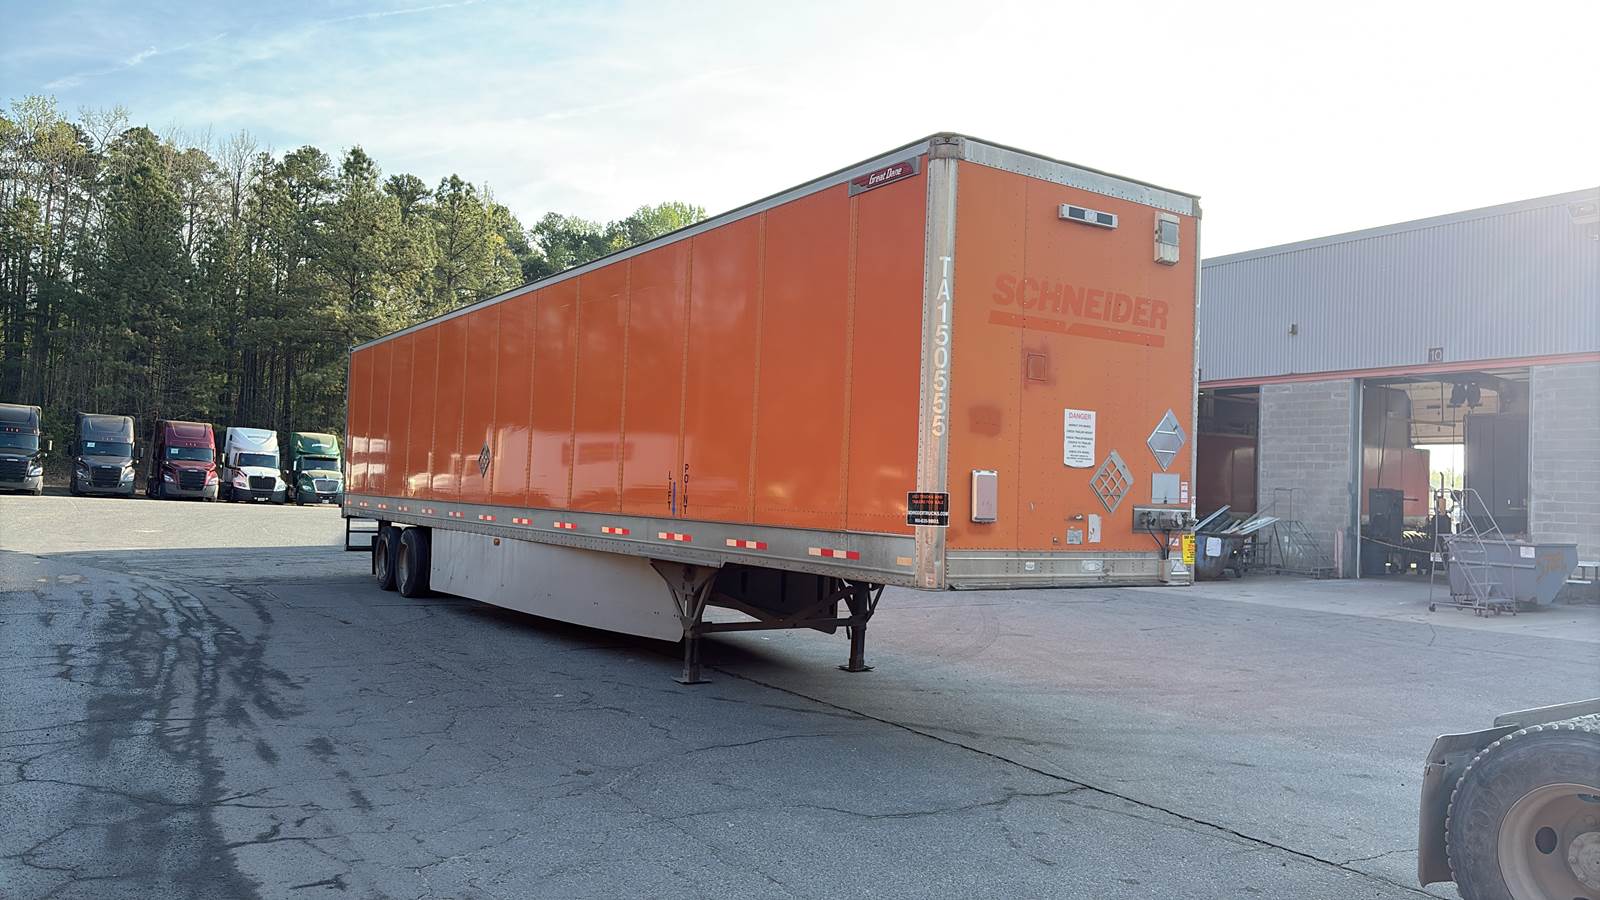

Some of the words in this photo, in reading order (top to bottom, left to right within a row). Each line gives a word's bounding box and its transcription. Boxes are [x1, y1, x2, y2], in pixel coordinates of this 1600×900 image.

[869, 172, 886, 185] Great
[885, 167, 902, 179] Dane
[991, 273, 1169, 330] SCHNEIDER
[1431, 350, 1442, 361] 10
[1069, 411, 1092, 420] DANGER
